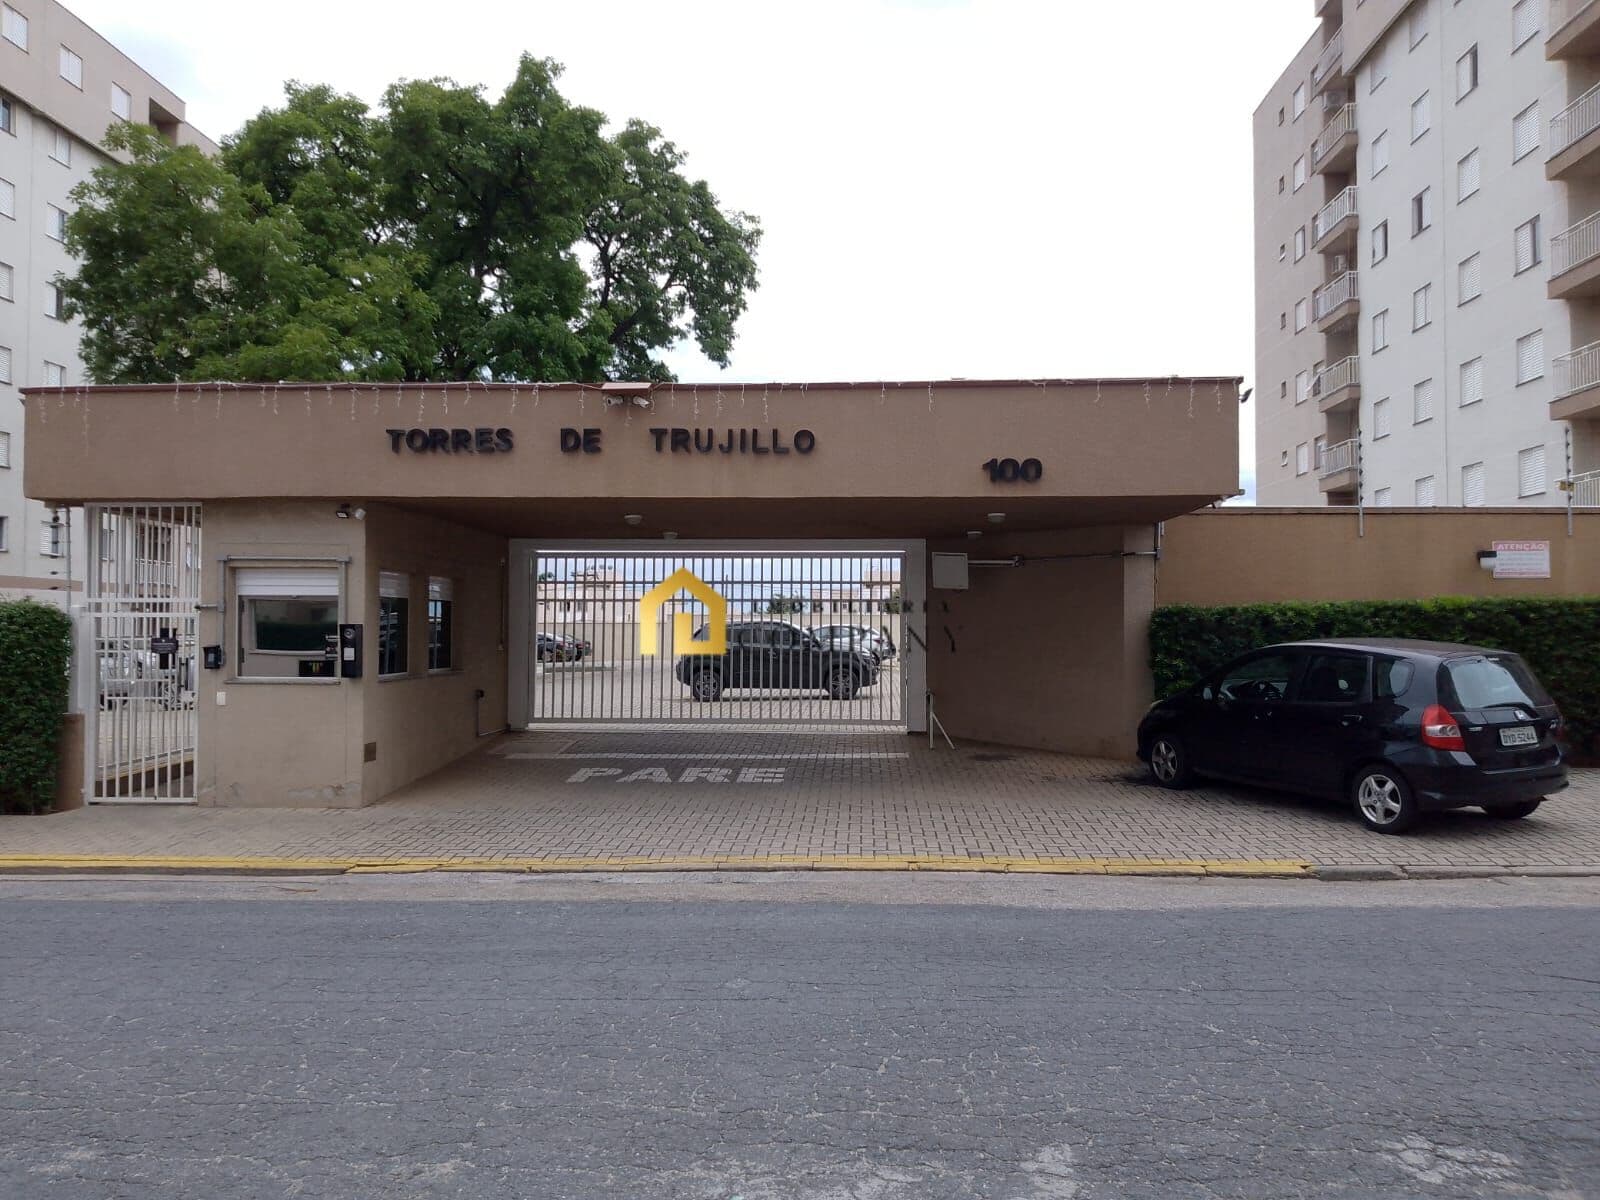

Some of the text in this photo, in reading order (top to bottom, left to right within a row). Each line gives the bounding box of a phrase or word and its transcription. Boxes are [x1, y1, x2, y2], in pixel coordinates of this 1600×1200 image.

[386, 428, 817, 454] TORRES DE TRUJILLO
[982, 458, 1043, 483] 100
[566, 767, 786, 783] PARE
